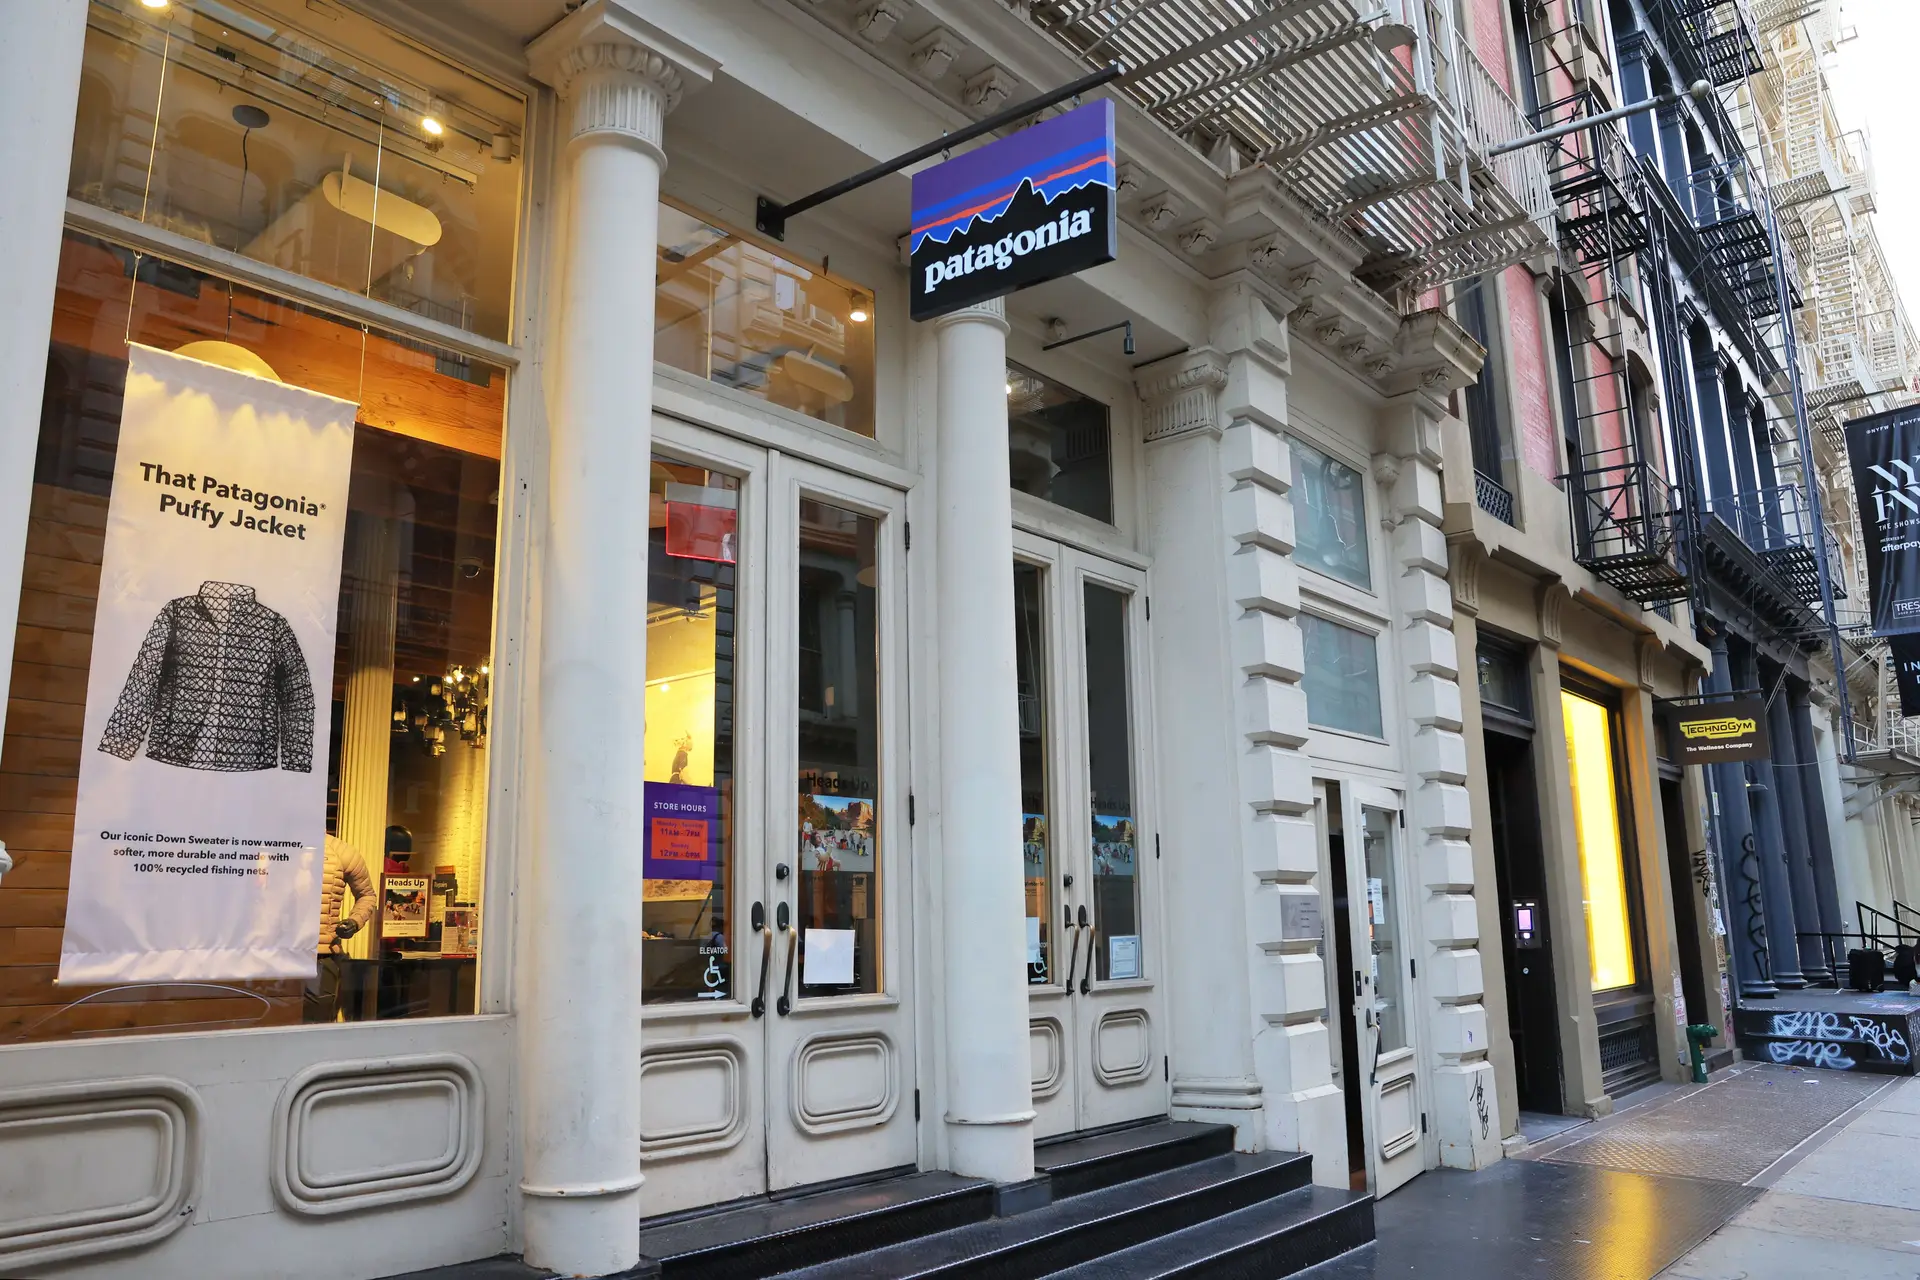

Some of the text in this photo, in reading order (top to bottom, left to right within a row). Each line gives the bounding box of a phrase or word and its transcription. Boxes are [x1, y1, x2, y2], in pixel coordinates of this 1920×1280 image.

[140, 462, 197, 491] That
[160, 494, 306, 541] Puffy Jacket
[1698, 744, 1725, 752] Wellness
[1725, 742, 1753, 750] Company
[653, 801, 707, 813] STORE HOURS
[100, 830, 304, 850] Our iconic Down Sweater is now warmer,
[113, 847, 290, 862] softer, more durable and made with
[133, 863, 269, 877] 100% recycled fishing nets.
[387, 878, 425, 888] Heads Up
[699, 946, 729, 955] ELEVATOR
